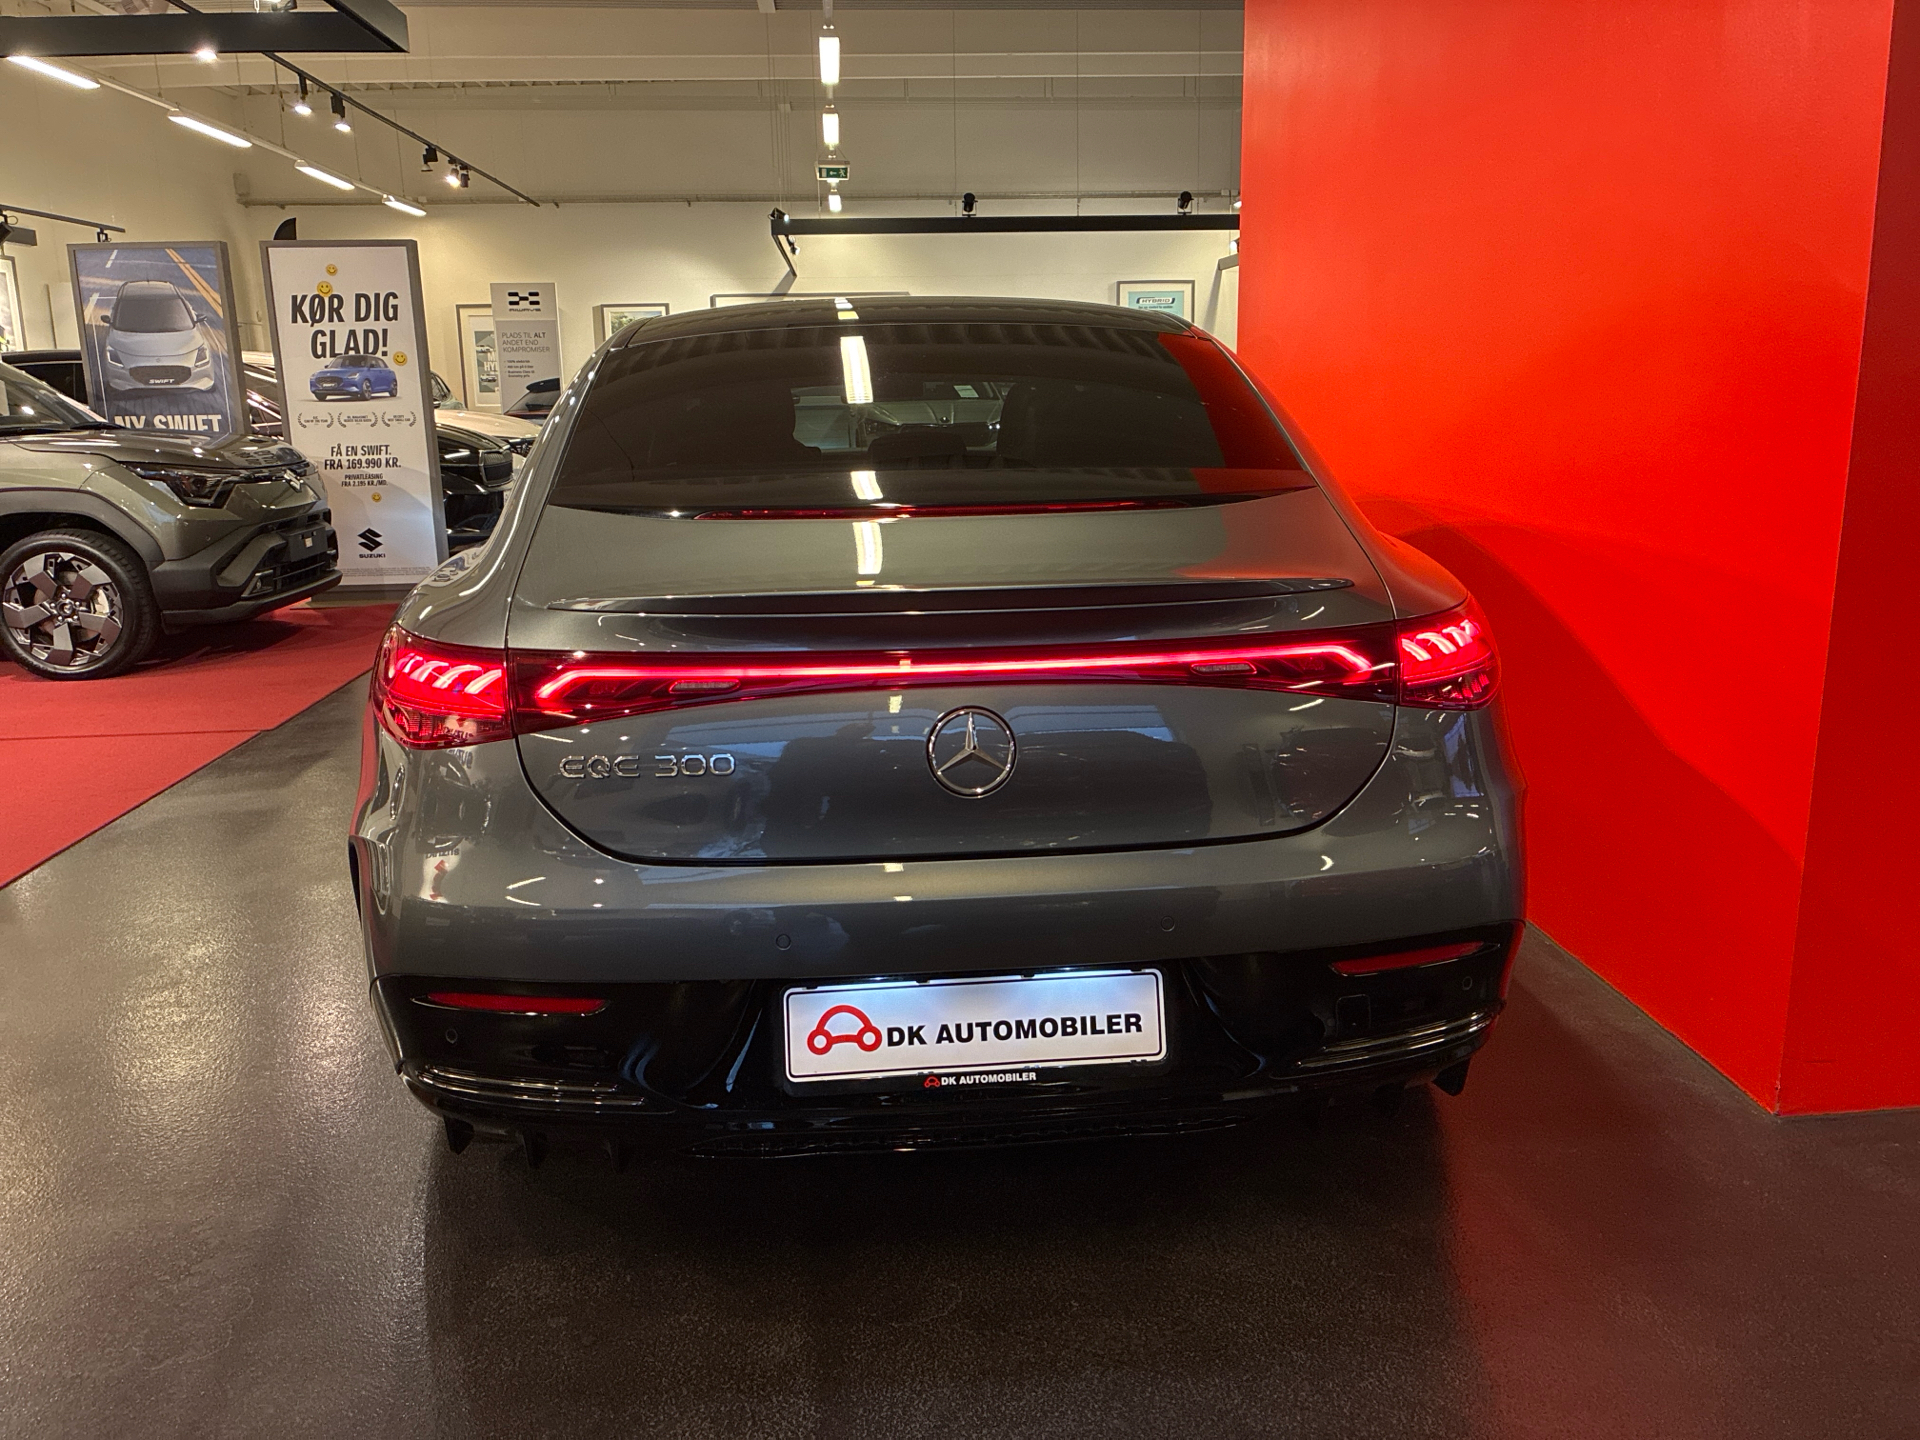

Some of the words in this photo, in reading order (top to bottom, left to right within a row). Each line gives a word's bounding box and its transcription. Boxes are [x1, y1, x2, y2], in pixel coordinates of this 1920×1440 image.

[291, 293, 345, 327] KØR
[354, 291, 399, 322] DIG
[310, 328, 388, 359] GLAD!
[153, 414, 222, 432] SWIFT
[330, 443, 343, 457] FÅ
[345, 445, 358, 456] EN
[361, 444, 392, 456] SWIFT.
[324, 459, 343, 470] FRA
[346, 458, 382, 469] 169.990
[385, 457, 402, 468] KR.
[559, 755, 640, 779] EQE
[654, 753, 736, 777] 300
[887, 1025, 927, 1047] DK
[935, 1012, 1143, 1044] AUTOMOBILER
[941, 1076, 957, 1086] DK
[959, 1072, 1037, 1085] AUTOMOBILER
